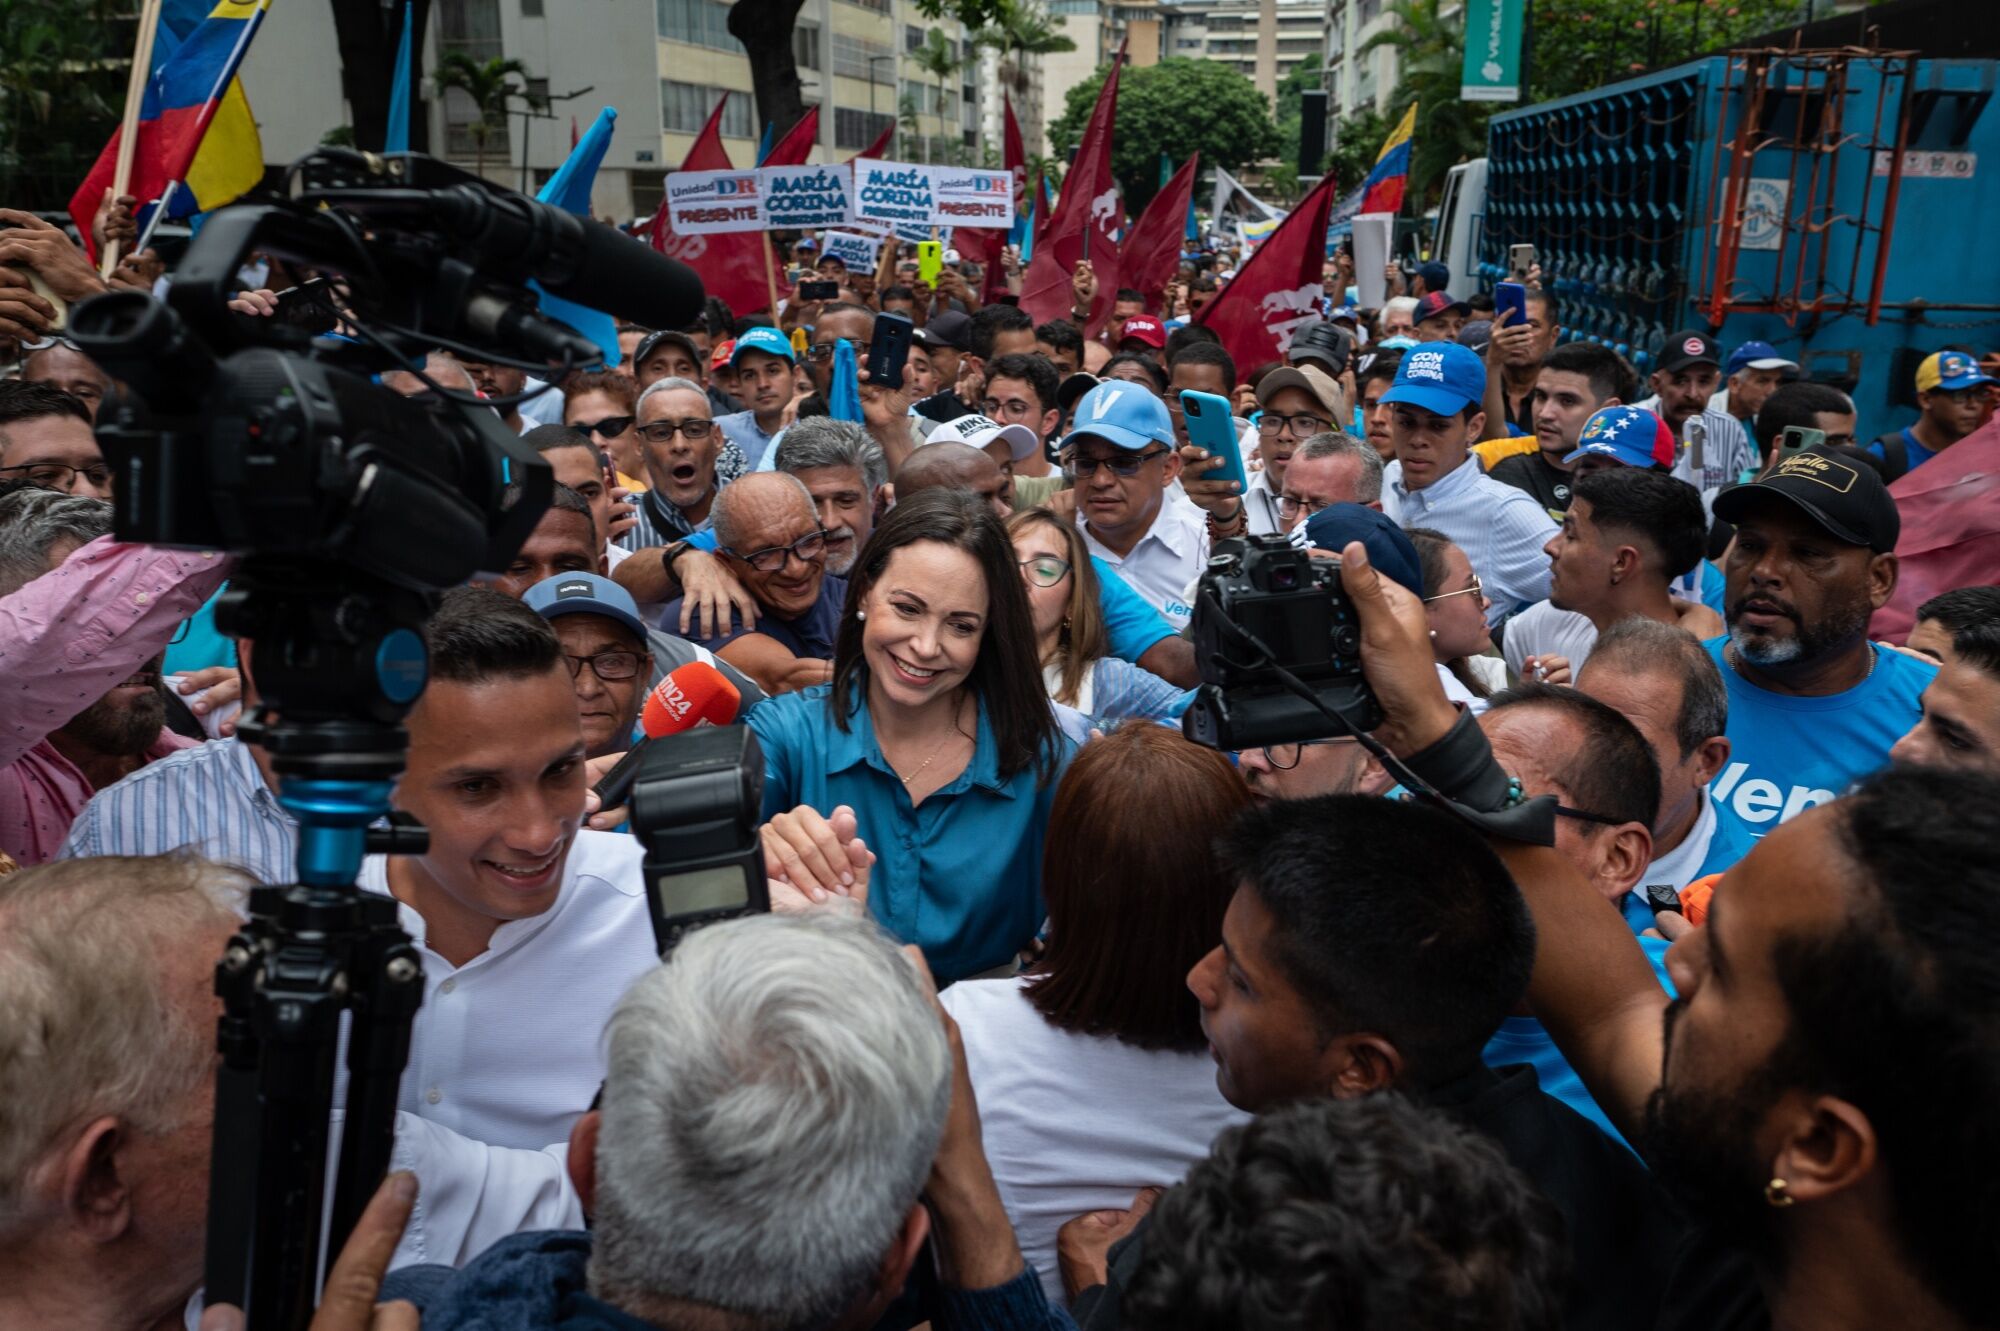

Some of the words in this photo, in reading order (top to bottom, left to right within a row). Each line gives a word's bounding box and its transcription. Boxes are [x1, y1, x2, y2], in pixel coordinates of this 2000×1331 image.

[771, 170, 842, 194] MARÍA
[867, 168, 930, 190] MARÍA
[671, 182, 715, 198] Unidad
[860, 186, 933, 208] CORINA
[765, 193, 848, 212] CORINA
[938, 201, 1006, 218] PRESENTE
[678, 205, 758, 224] PRESENTE
[832, 238, 871, 253] MARÍA
[1411, 352, 1445, 362] CON
[1408, 361, 1441, 371] MARÍA
[1407, 369, 1444, 382] CORINA
